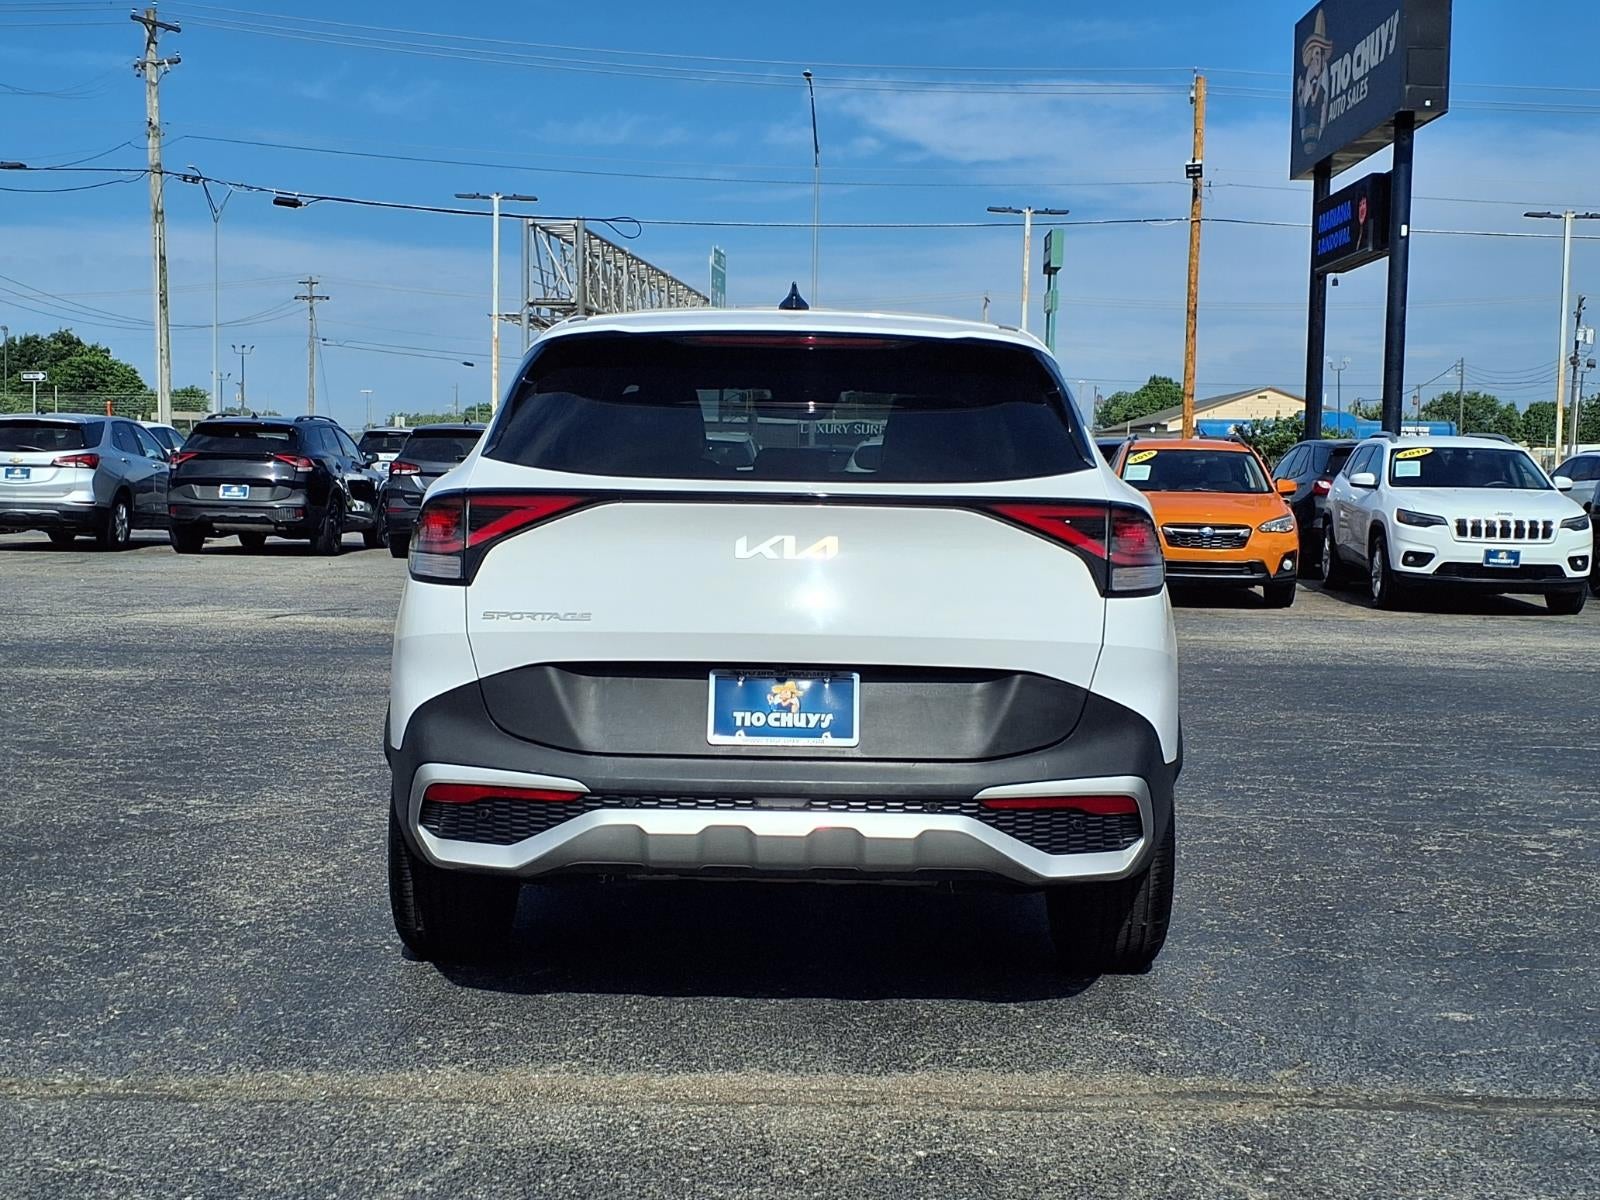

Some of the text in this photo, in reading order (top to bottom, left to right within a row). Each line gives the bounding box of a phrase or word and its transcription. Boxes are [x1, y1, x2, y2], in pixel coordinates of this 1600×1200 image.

[1330, 8, 1399, 99] TIO CHUY'S
[1328, 77, 1368, 123] AUTO SALES
[800, 423, 850, 434] LXURY
[734, 535, 838, 559] KIA
[481, 610, 592, 622] SPORTAGE
